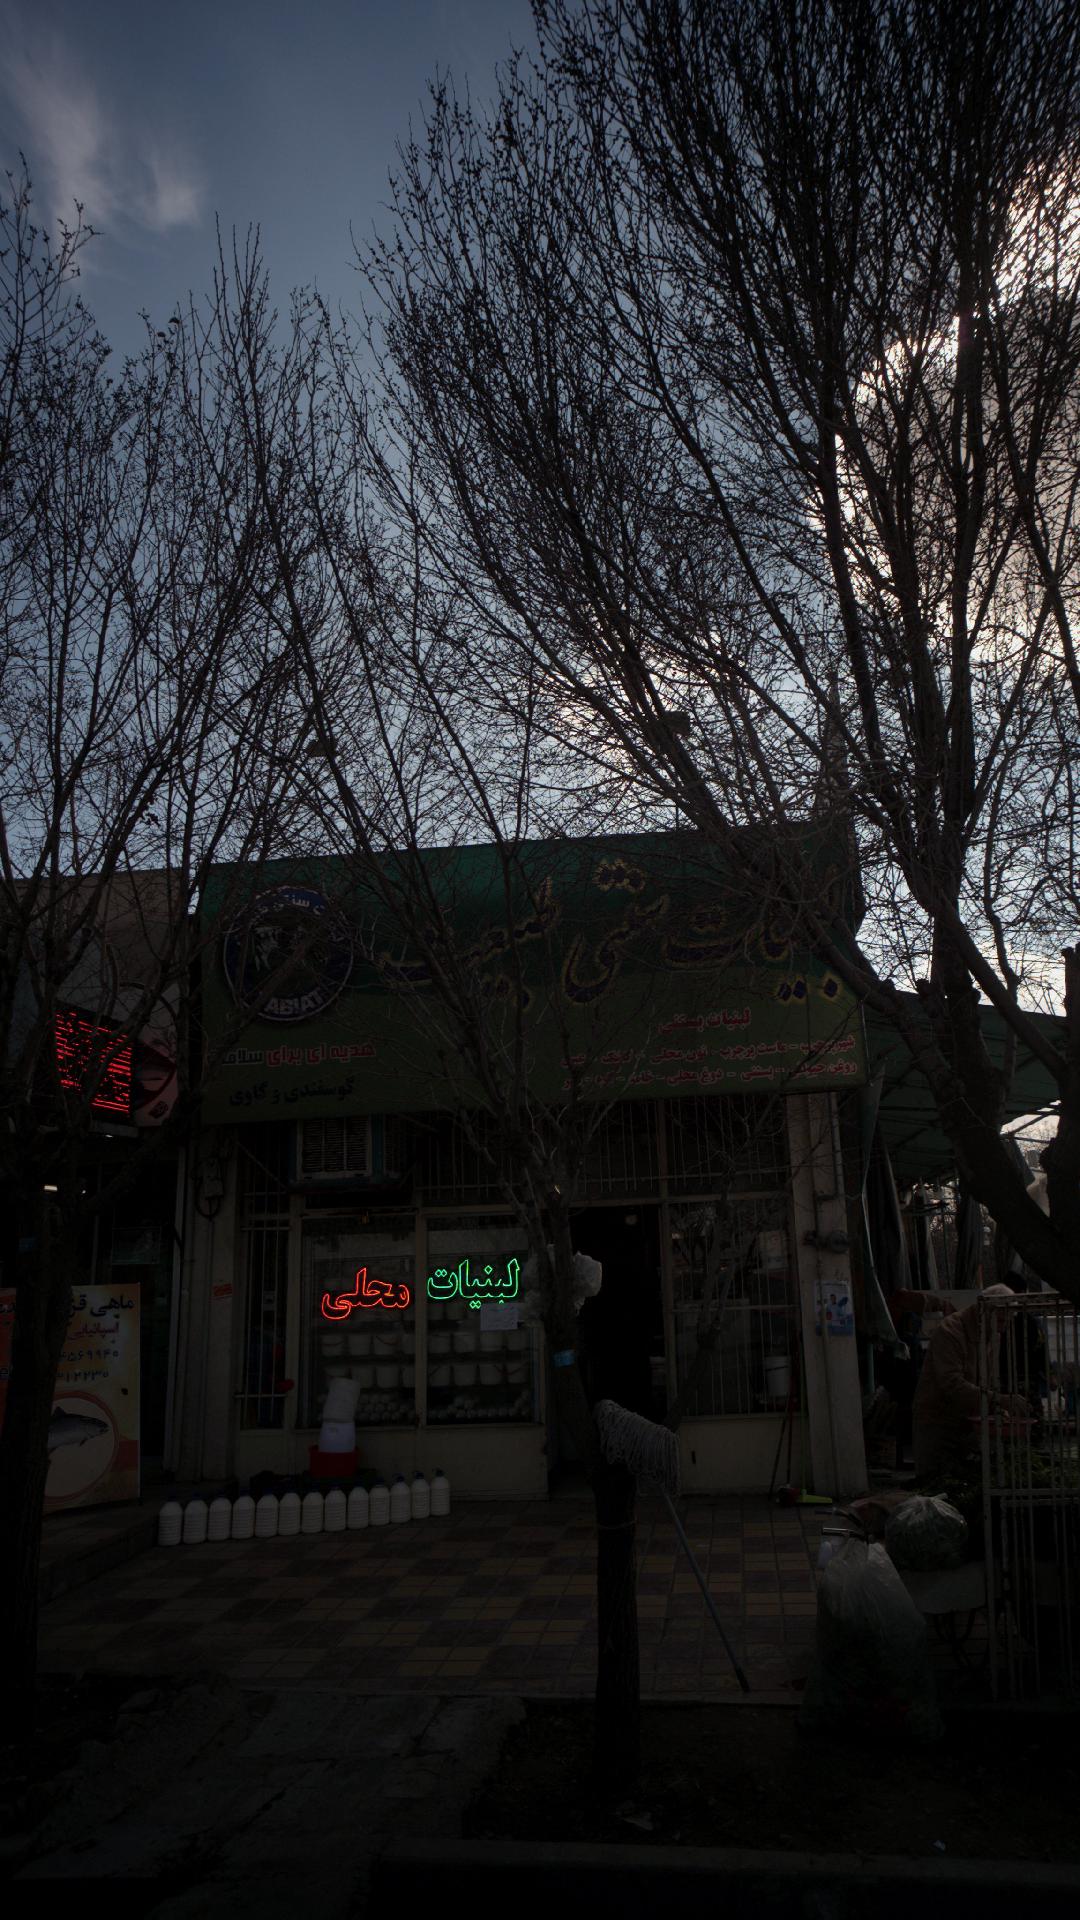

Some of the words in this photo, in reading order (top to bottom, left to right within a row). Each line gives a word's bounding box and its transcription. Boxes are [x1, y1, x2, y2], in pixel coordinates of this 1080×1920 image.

[706, 1006, 752, 1031] لبنیات
[264, 1045, 304, 1068] برای
[306, 1043, 327, 1064] ای
[329, 1042, 377, 1064] هدیه
[666, 1068, 698, 1086] محلی
[229, 1080, 269, 1105] گاوی
[320, 1265, 411, 1321] محلی
[425, 1257, 521, 1310] لبنیات
[90, 1294, 135, 1320] ماهی
